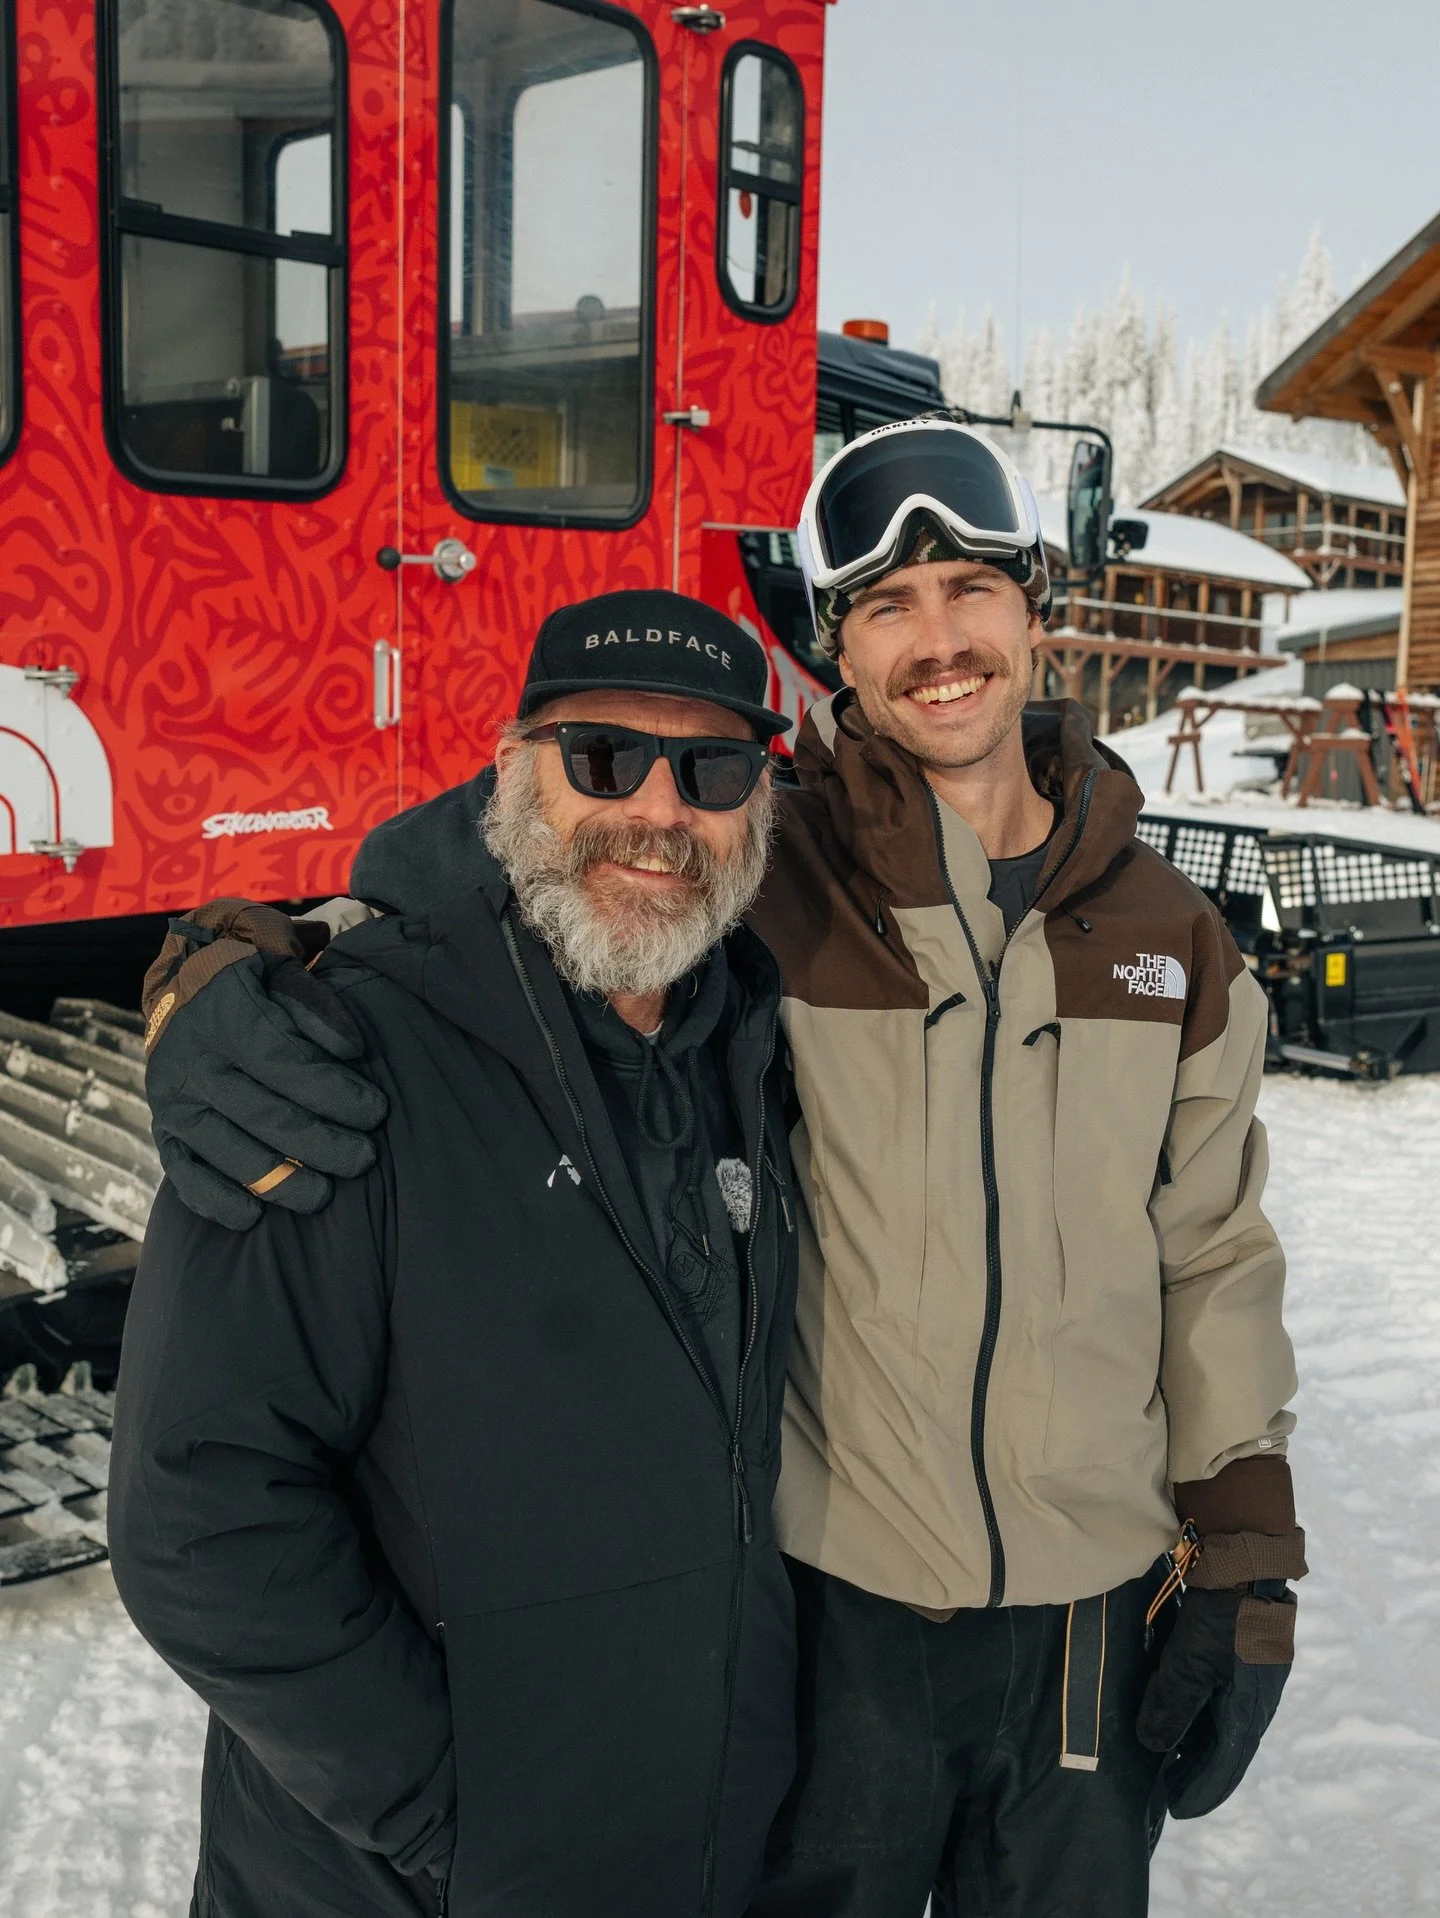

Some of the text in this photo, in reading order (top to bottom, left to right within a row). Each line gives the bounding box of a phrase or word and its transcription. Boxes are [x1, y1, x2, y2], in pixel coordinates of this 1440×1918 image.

[871, 420, 929, 436] OAKLEY
[585, 628, 731, 671] BALDFACE
[1135, 953, 1166, 969] THE
[1112, 963, 1165, 983] NORTH
[1127, 980, 1165, 997] FACE
